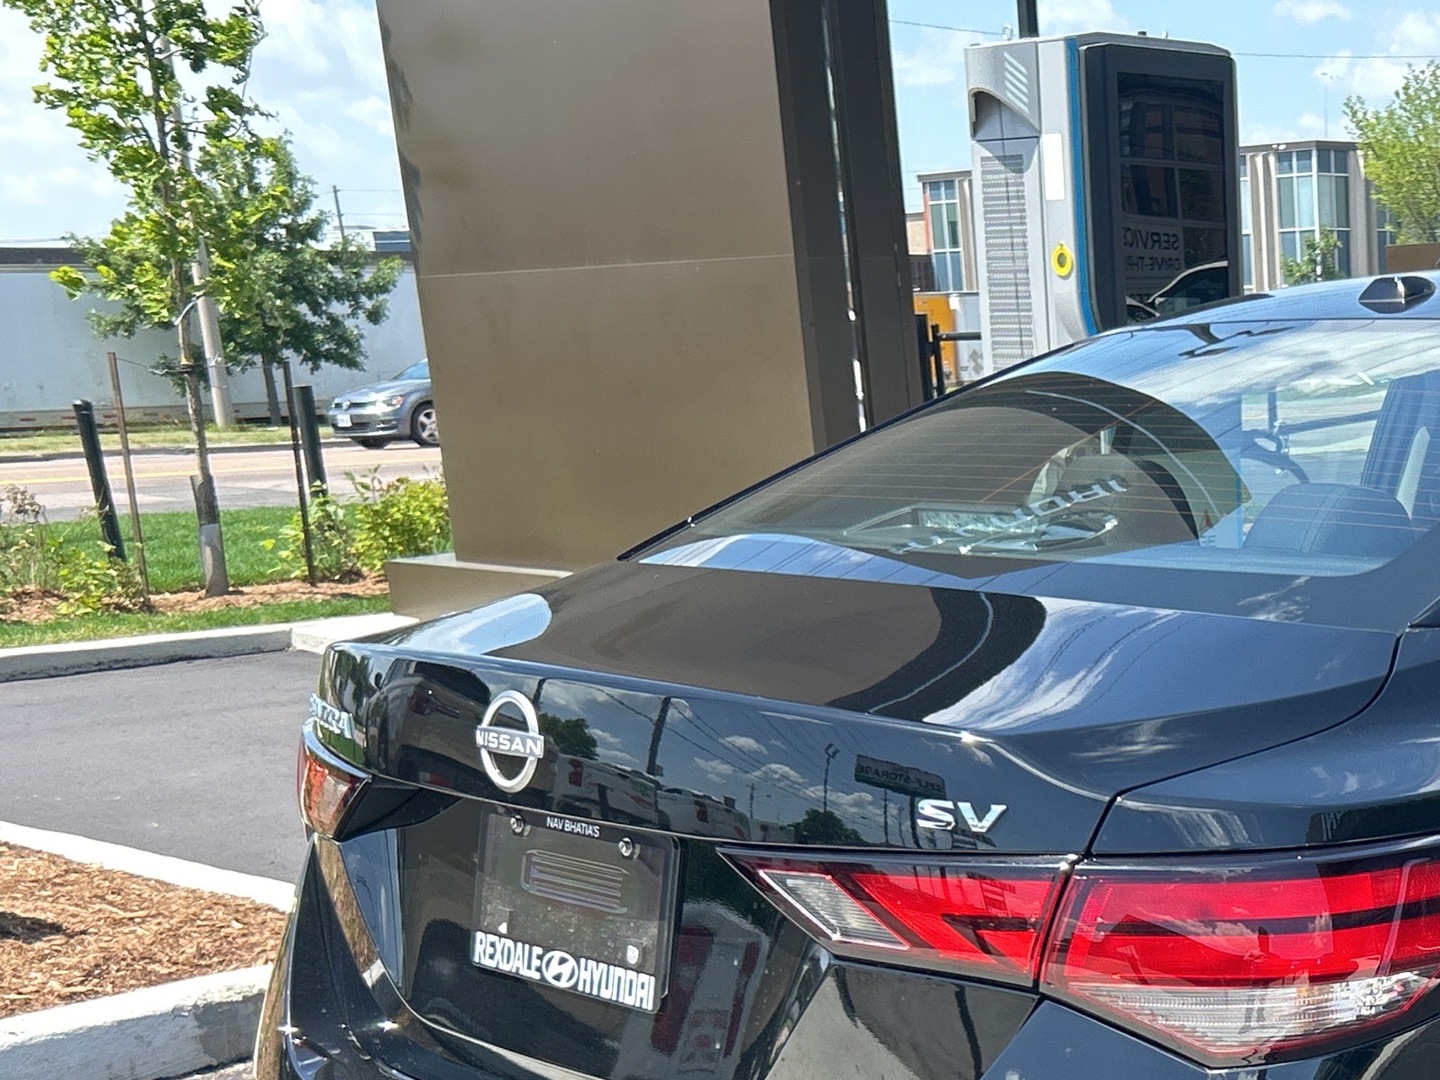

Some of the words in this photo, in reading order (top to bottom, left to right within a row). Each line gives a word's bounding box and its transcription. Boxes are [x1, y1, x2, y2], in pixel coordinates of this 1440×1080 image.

[476, 729, 541, 755] NISSAN
[546, 816, 565, 831] NAV
[564, 820, 600, 838] BHATIA'S
[916, 798, 1008, 833] SV
[473, 931, 543, 980] REXDALE
[578, 957, 656, 1011] HYUNDAI
